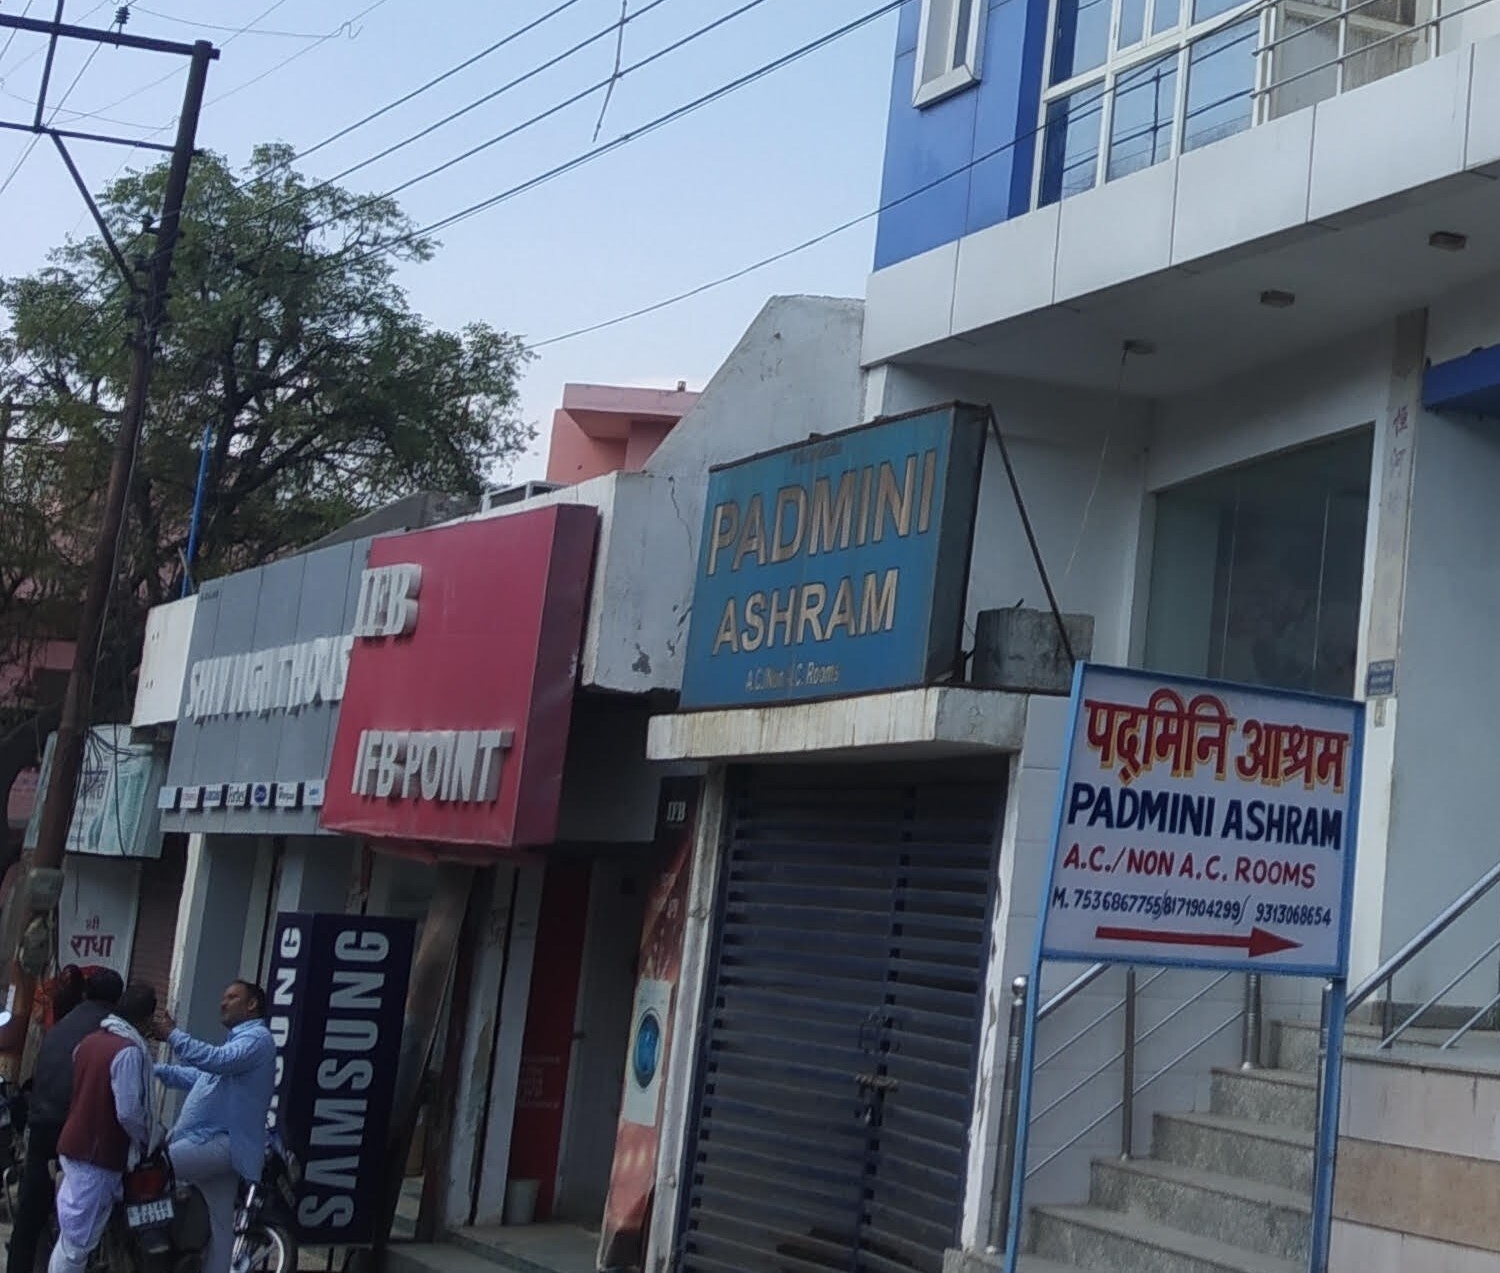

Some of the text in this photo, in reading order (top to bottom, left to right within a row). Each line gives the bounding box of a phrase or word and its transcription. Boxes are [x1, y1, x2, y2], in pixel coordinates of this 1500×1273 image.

[708, 449, 937, 575] PADMINI
[711, 567, 899, 657] ASHRAM
[402, 729, 515, 803] POINT
[1235, 718, 1352, 793] आश्रम
[1066, 781, 1343, 851] PADMINI ASHRAM
[1063, 842, 1317, 889] A.C./NON A.C. ROOMS
[71, 935, 115, 958] राधा
[299, 930, 391, 1227] SAMSUNG
